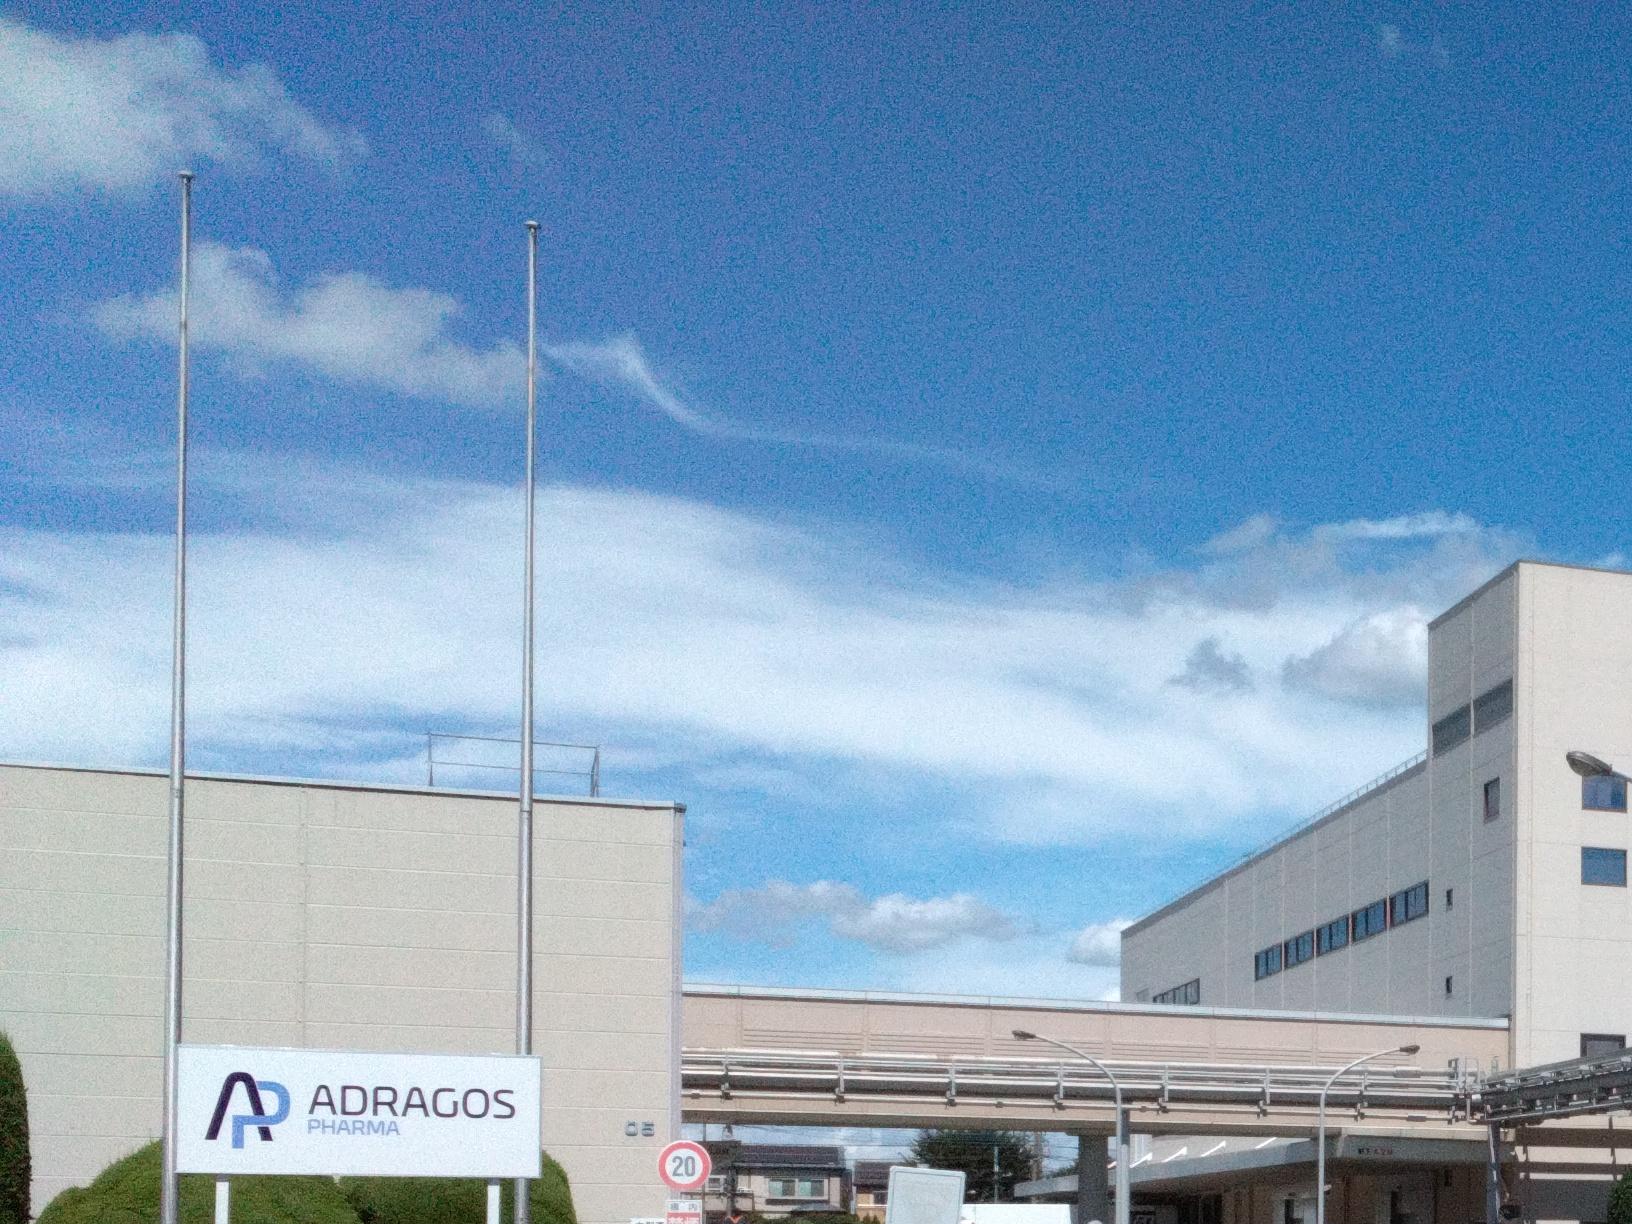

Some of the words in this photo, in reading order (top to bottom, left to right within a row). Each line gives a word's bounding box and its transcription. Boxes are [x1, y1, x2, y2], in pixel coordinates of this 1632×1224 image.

[308, 1083, 516, 1119] ADRAGOS
[306, 1118, 401, 1136] PHARMA
[671, 1155, 696, 1177] 20
